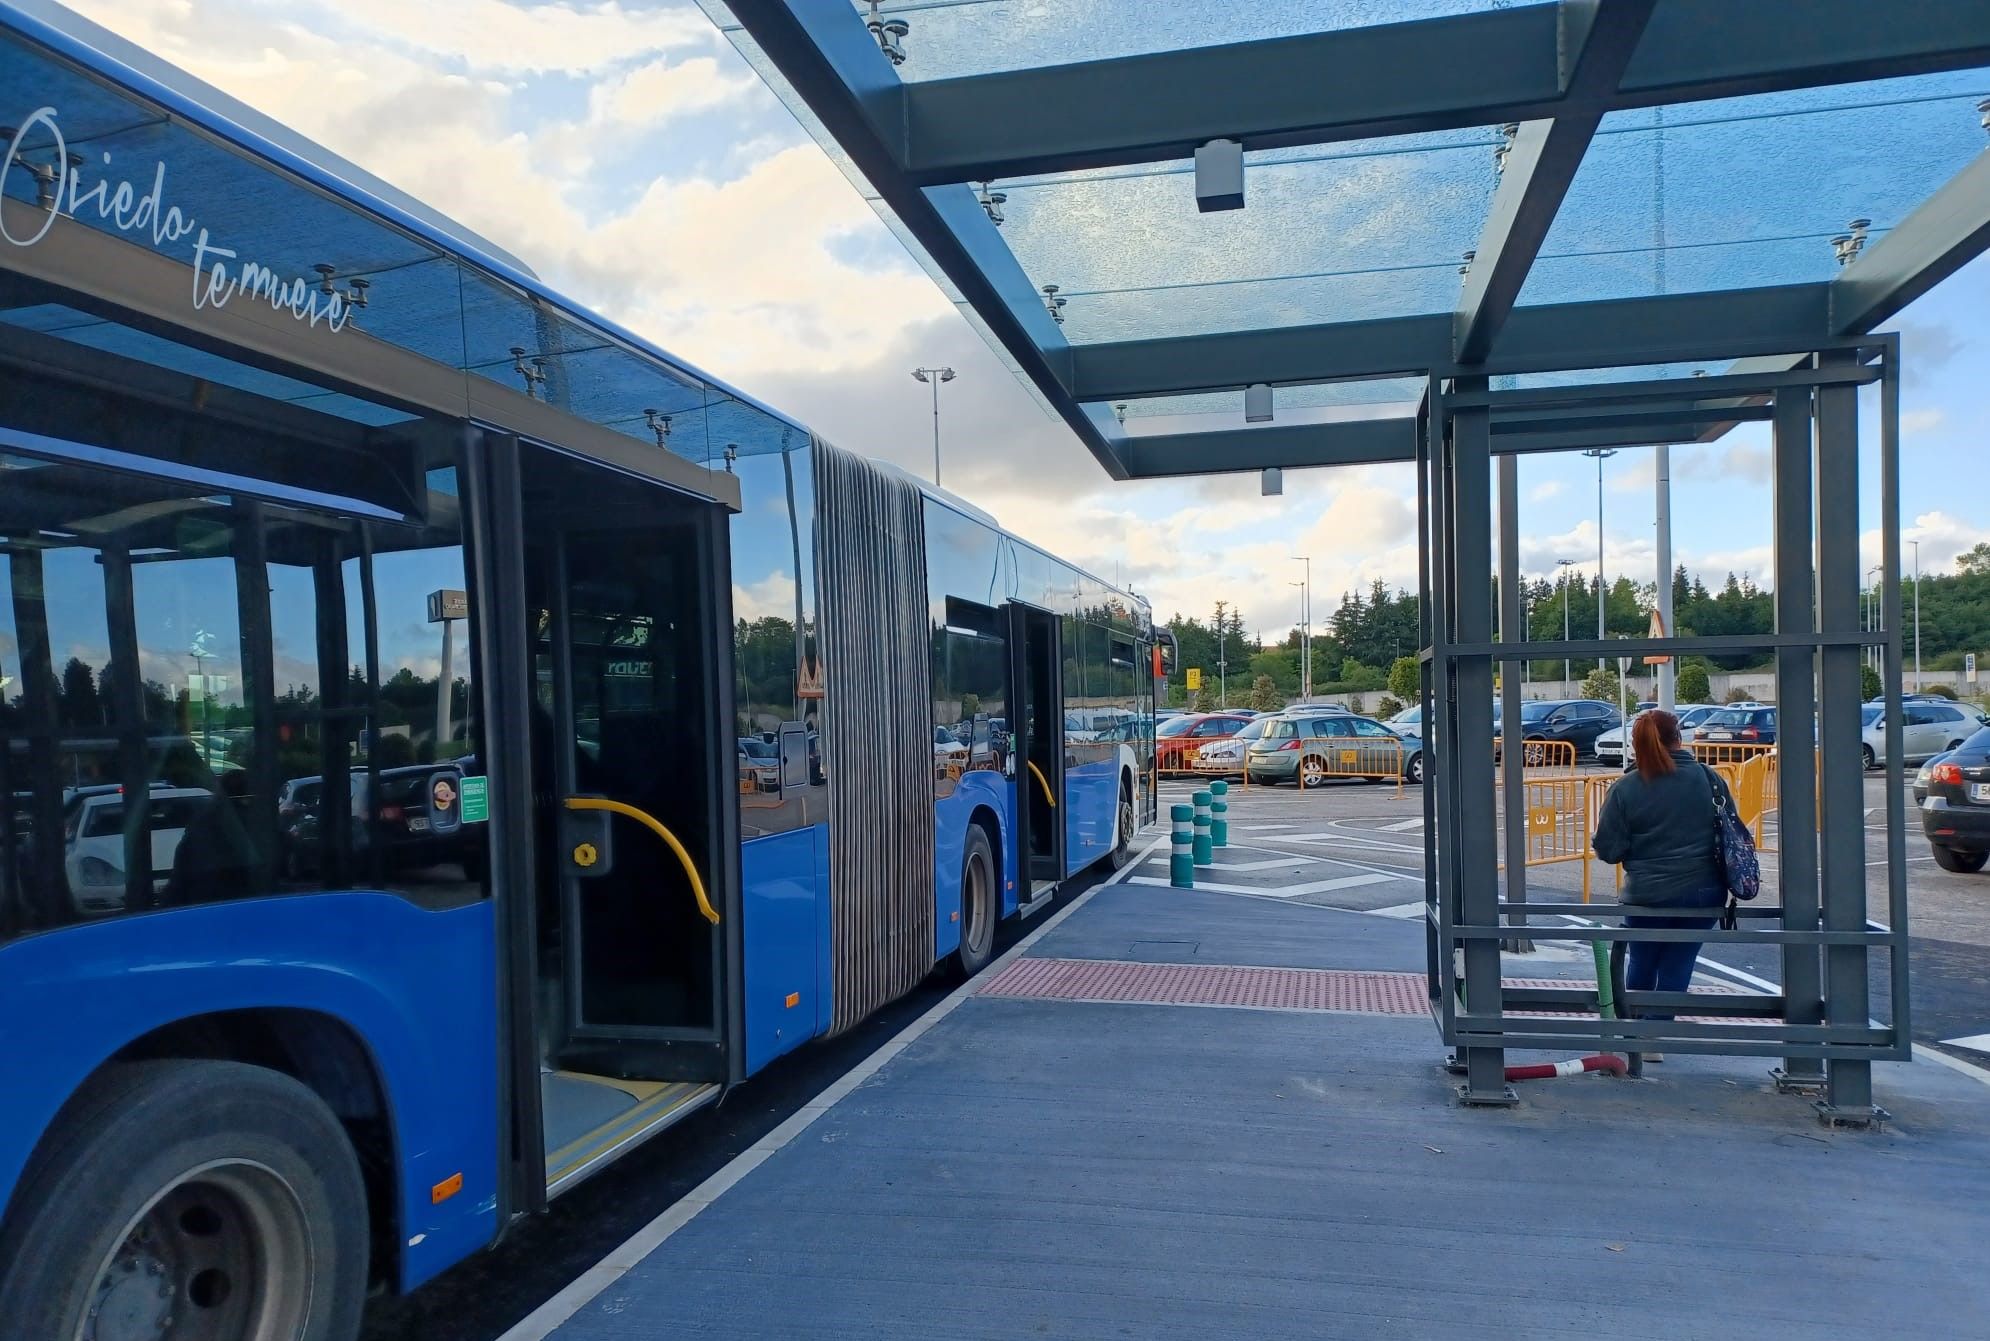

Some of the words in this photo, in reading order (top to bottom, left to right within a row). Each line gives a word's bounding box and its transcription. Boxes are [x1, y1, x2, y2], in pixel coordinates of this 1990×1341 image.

[0, 106, 195, 246] Oviedo
[192, 228, 237, 310] te
[239, 262, 350, 333] mueve
